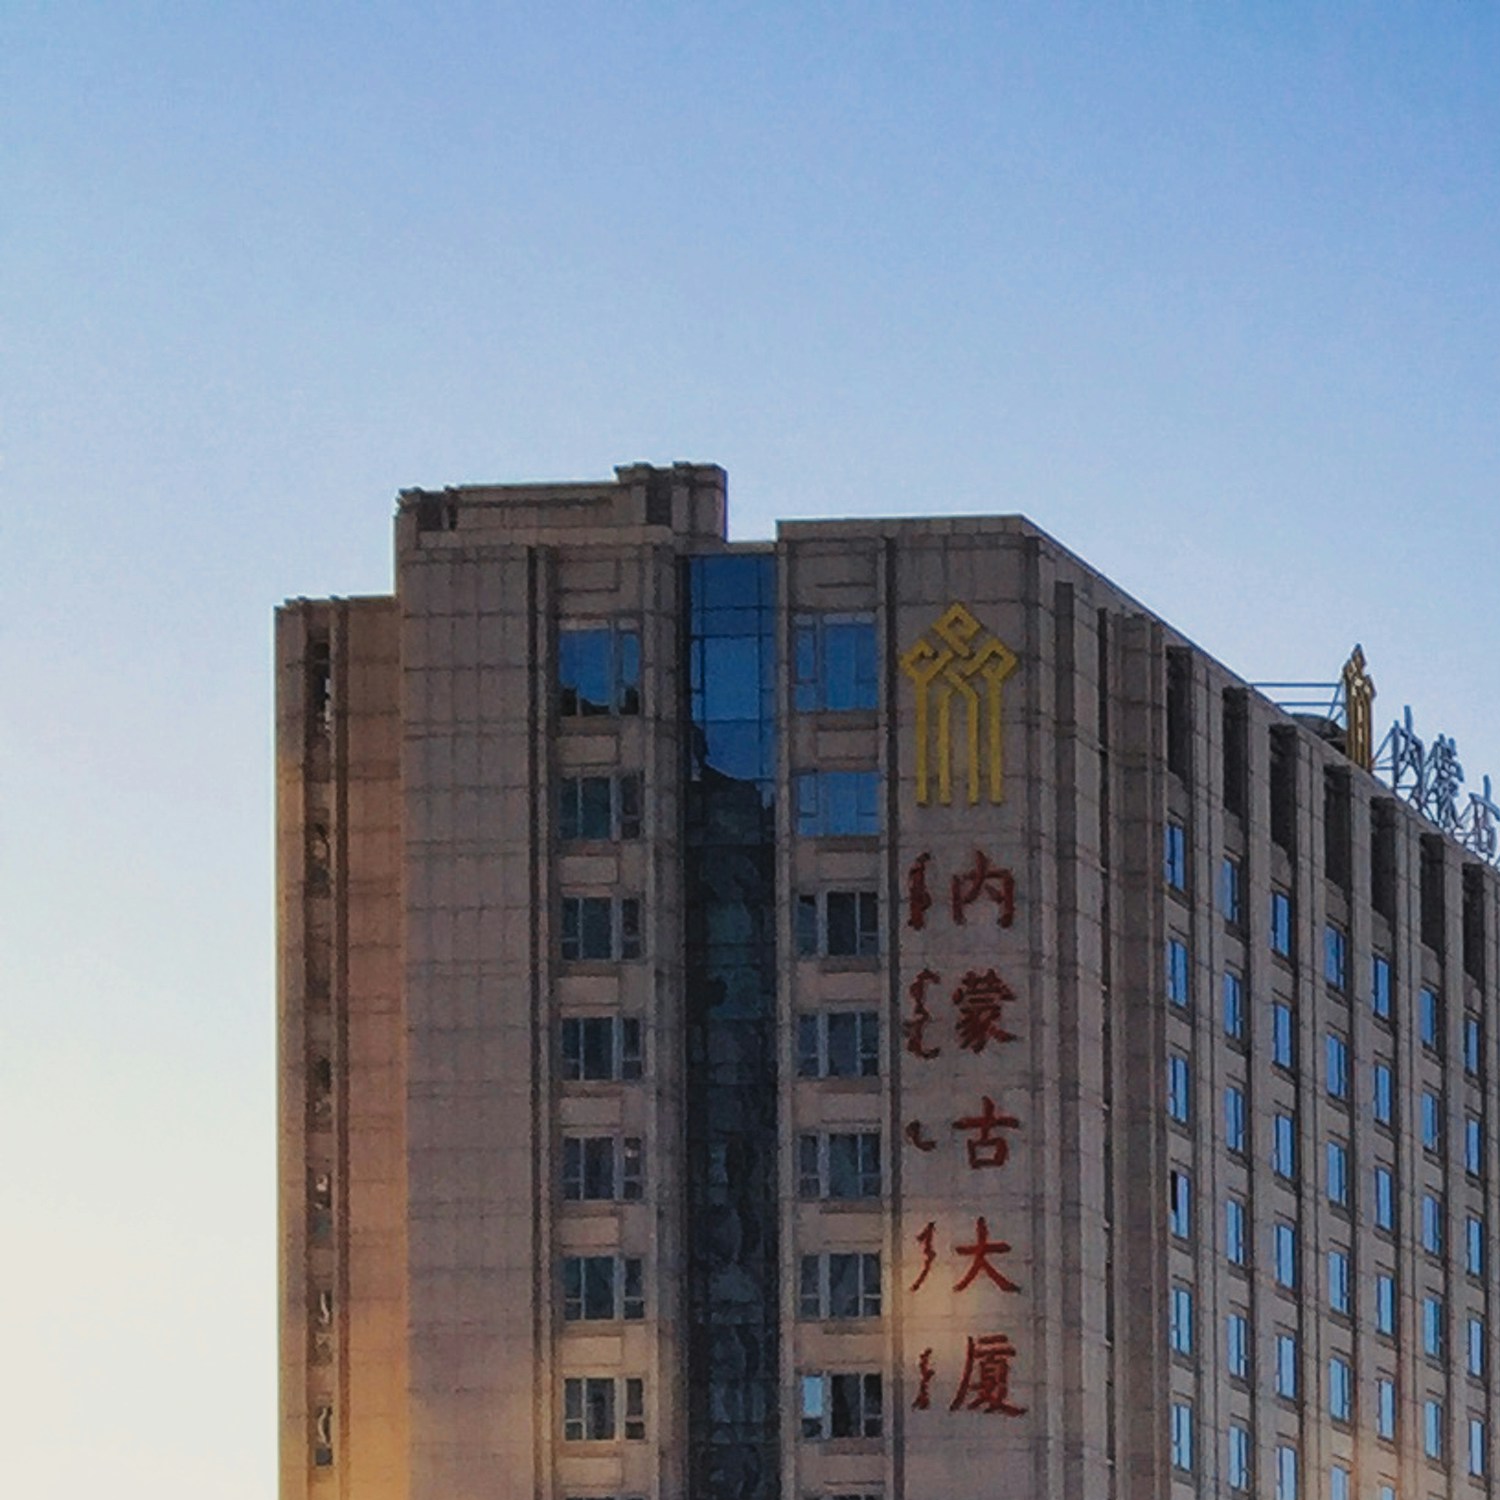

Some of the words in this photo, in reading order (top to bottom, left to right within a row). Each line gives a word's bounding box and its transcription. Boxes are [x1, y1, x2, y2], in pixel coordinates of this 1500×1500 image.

[949, 849, 1028, 1418] 内蒙古大厦
